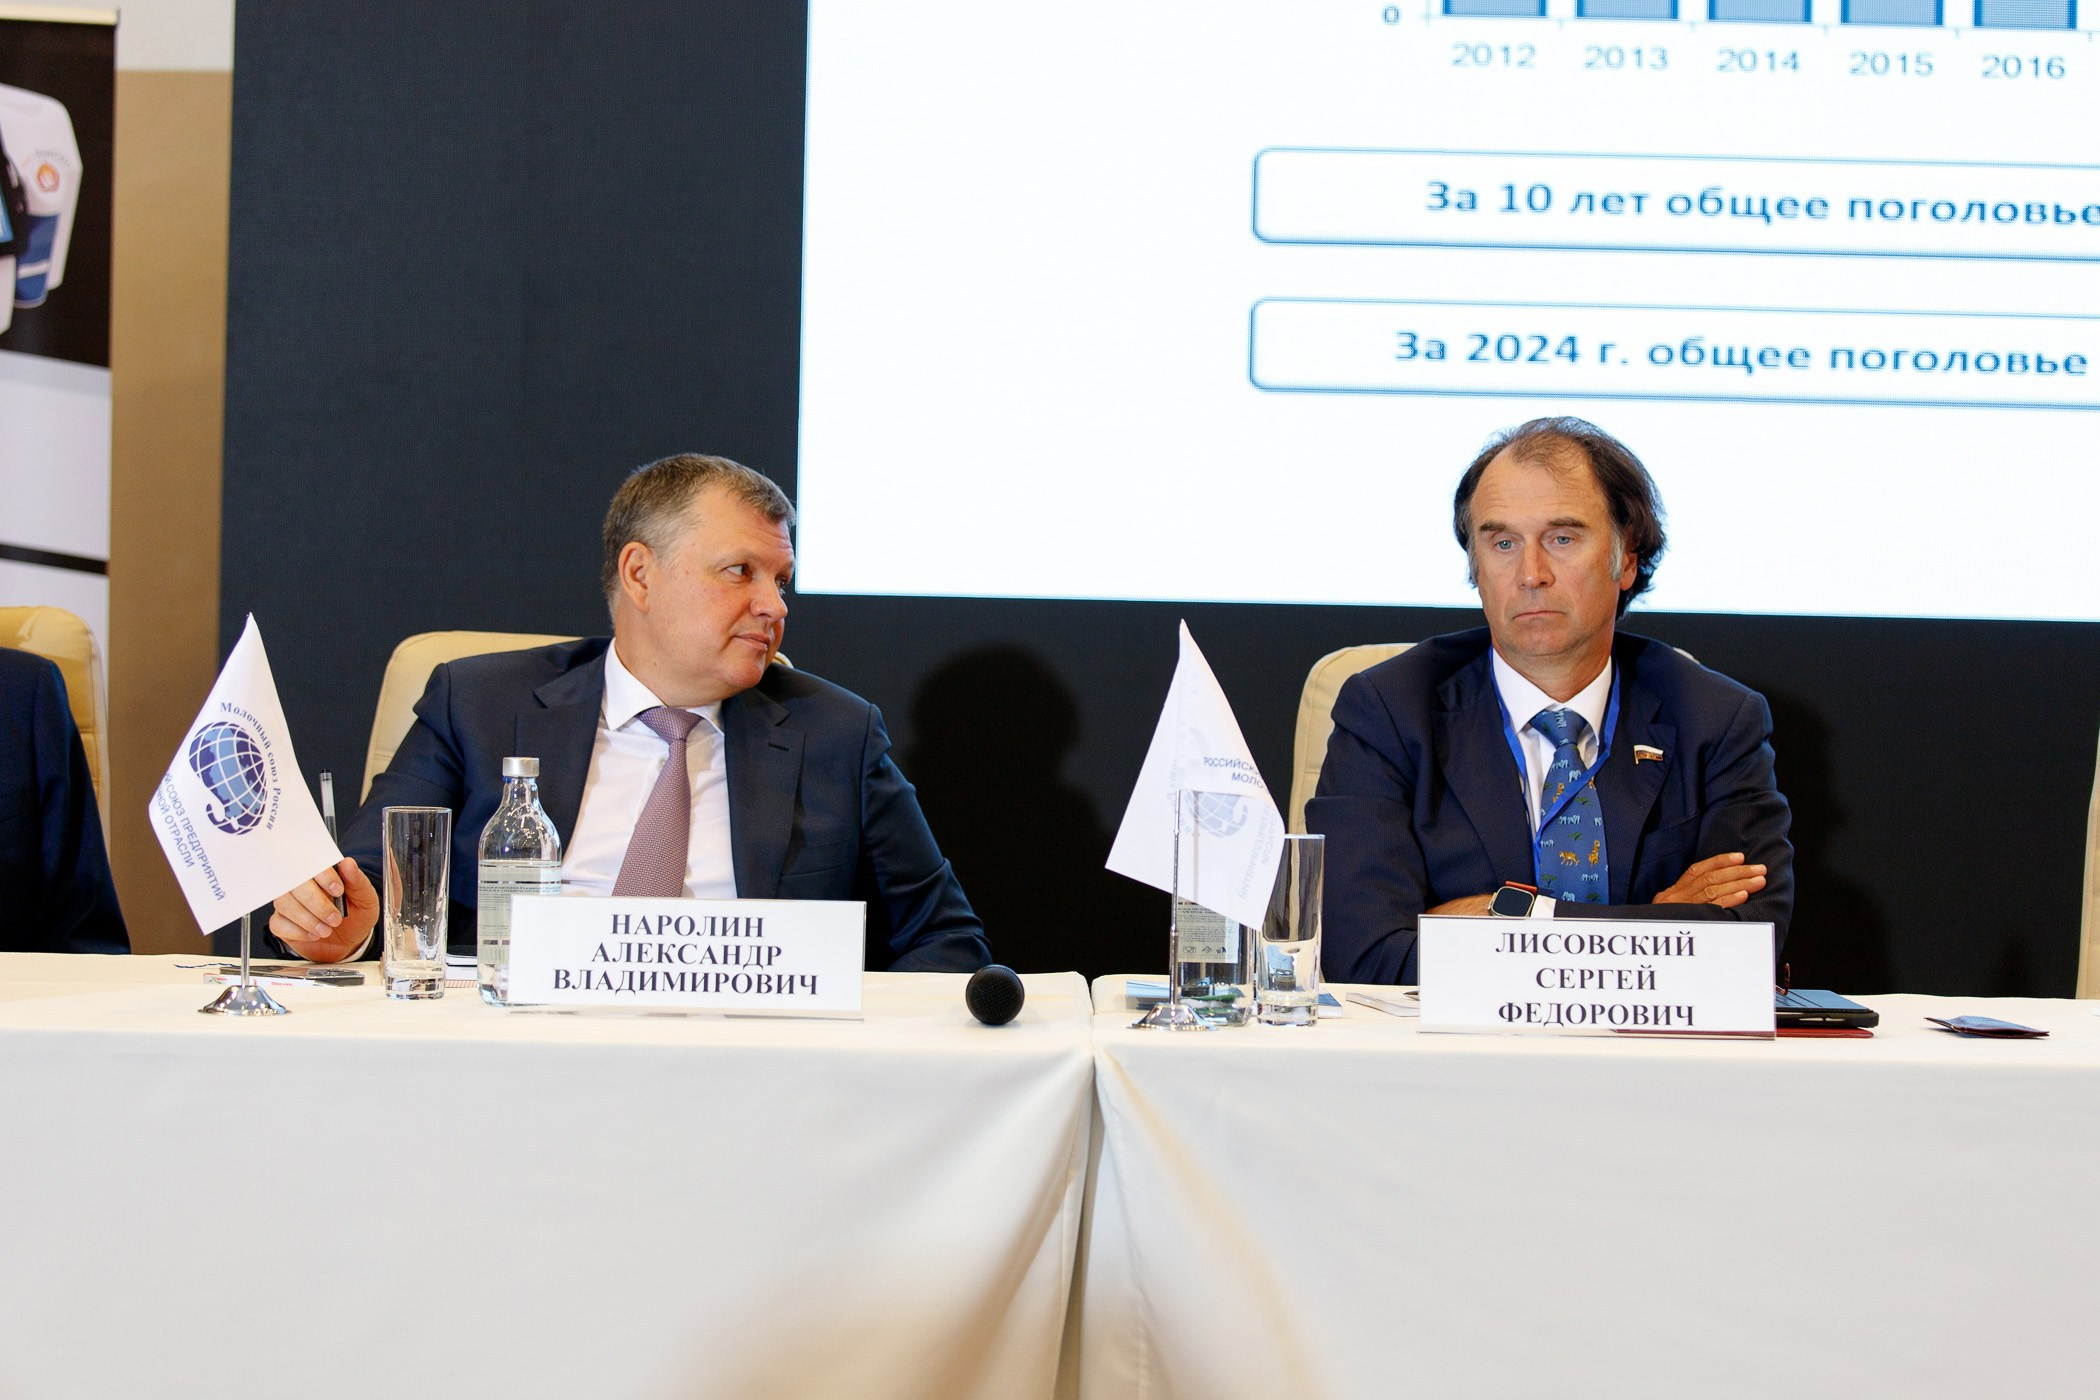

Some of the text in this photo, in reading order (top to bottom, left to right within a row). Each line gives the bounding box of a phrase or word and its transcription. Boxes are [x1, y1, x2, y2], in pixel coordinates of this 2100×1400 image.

[1382, 4, 1401, 25] 0
[1452, 43, 2067, 79] 2012 2013 2014 2015 2016
[1426, 180, 2100, 227] За 10 лет общее поголовье
[1395, 330, 2089, 377] За 2024 г. общее поголовье
[220, 702, 281, 831] Молочный союз России
[164, 815, 195, 868] ОТРАСЛИ
[167, 784, 226, 901] СОЮЗ ПРЕДПРИЯТИЙ
[611, 913, 764, 939] НАРОЛИН
[591, 942, 782, 970] АЛЕКСАНДР
[1495, 930, 1696, 957] ЛИСОВСКИЙ
[554, 968, 818, 996] ВЛАДИМИРОВИЧ
[1535, 963, 1657, 991] СЕРГЕЙ
[1498, 1002, 1694, 1028] ФЕДОРОВИЧ
